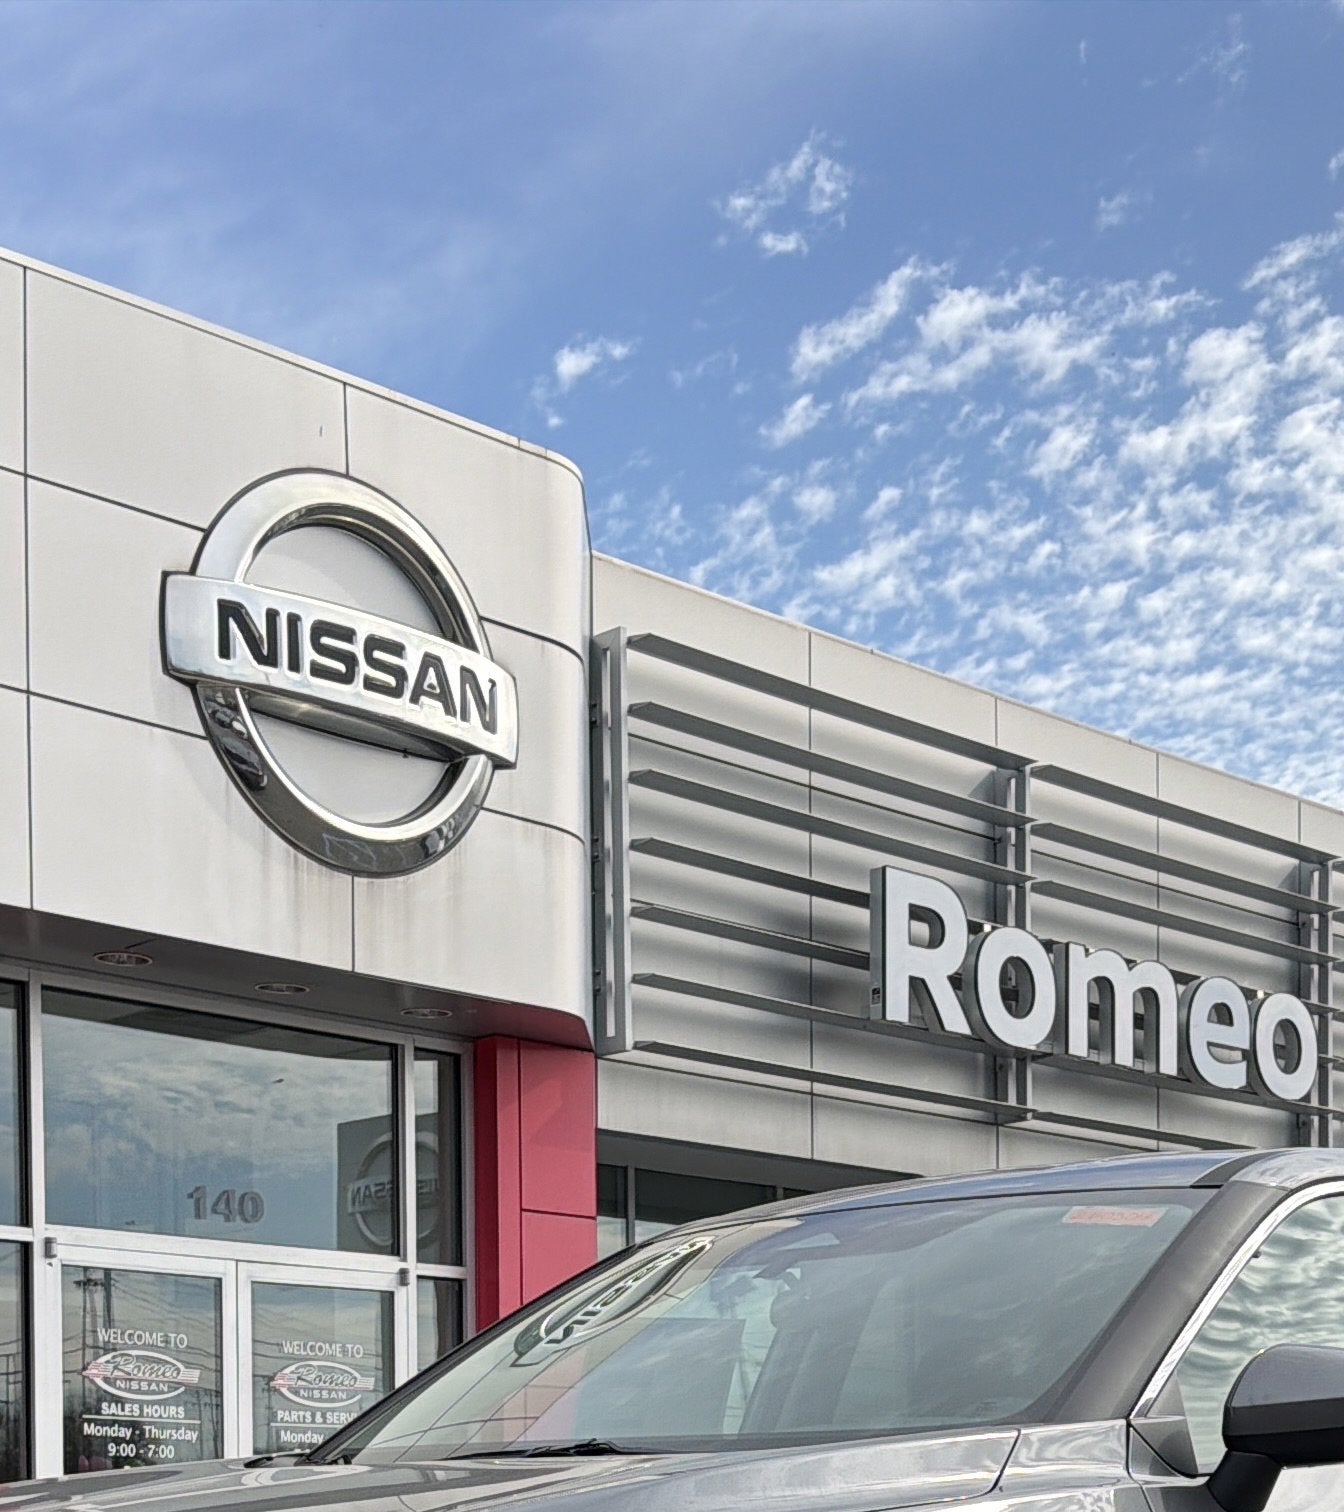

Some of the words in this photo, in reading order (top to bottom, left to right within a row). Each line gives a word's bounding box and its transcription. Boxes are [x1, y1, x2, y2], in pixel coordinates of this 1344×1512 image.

[216, 597, 498, 736] NISSAN
[870, 865, 1318, 1101] Romeo
[187, 1185, 264, 1223] 140
[97, 1327, 166, 1348] WELCOME
[168, 1332, 189, 1349] TO
[282, 1340, 343, 1357] WELCOME
[345, 1344, 364, 1358] TO
[104, 1352, 181, 1378] Romeo
[293, 1364, 359, 1387] Romeo
[116, 1379, 169, 1393] NISSAN
[299, 1388, 347, 1400] NISSAN
[101, 1401, 140, 1417] SALES
[143, 1404, 185, 1419] HOURS
[277, 1409, 312, 1424] PARTS
[315, 1411, 324, 1424] &
[83, 1422, 133, 1440] Monday
[143, 1425, 199, 1443] Thursday
[280, 1429, 325, 1444] Monday
[107, 1442, 137, 1458] 9:00
[147, 1444, 175, 1459] 7:00
